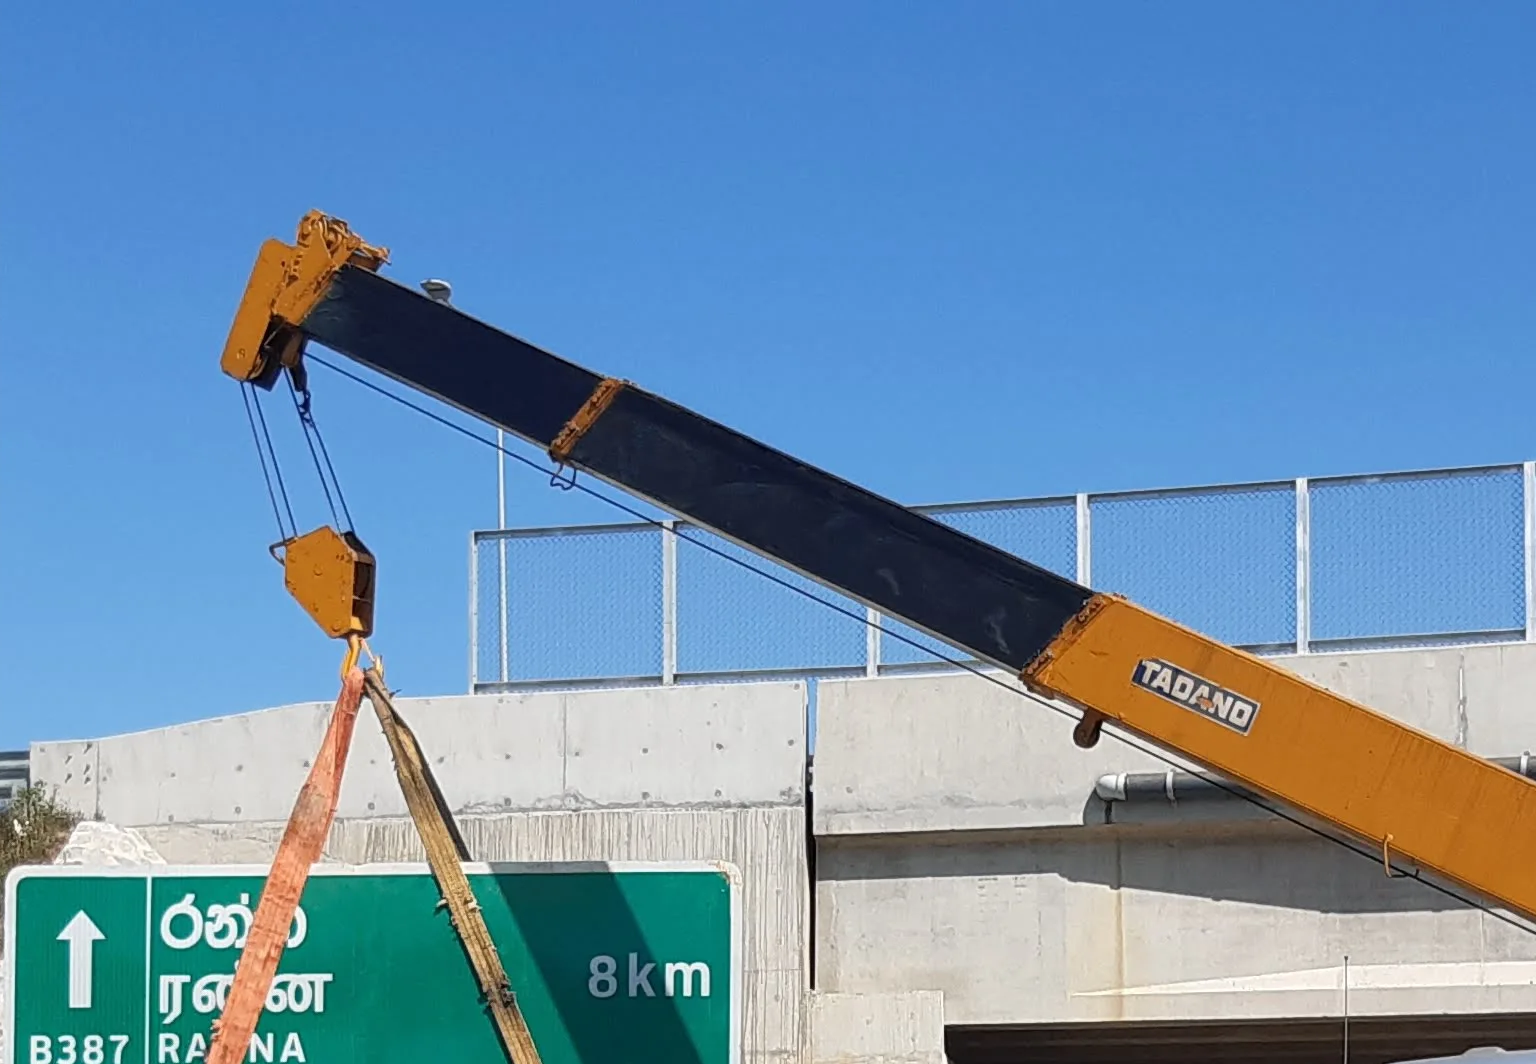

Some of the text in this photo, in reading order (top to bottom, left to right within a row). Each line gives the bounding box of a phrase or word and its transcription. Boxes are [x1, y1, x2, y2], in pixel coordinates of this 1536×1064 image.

[1141, 659, 1253, 728] TADANO
[588, 952, 711, 998] 8km
[158, 1032, 306, 1064] RANA
